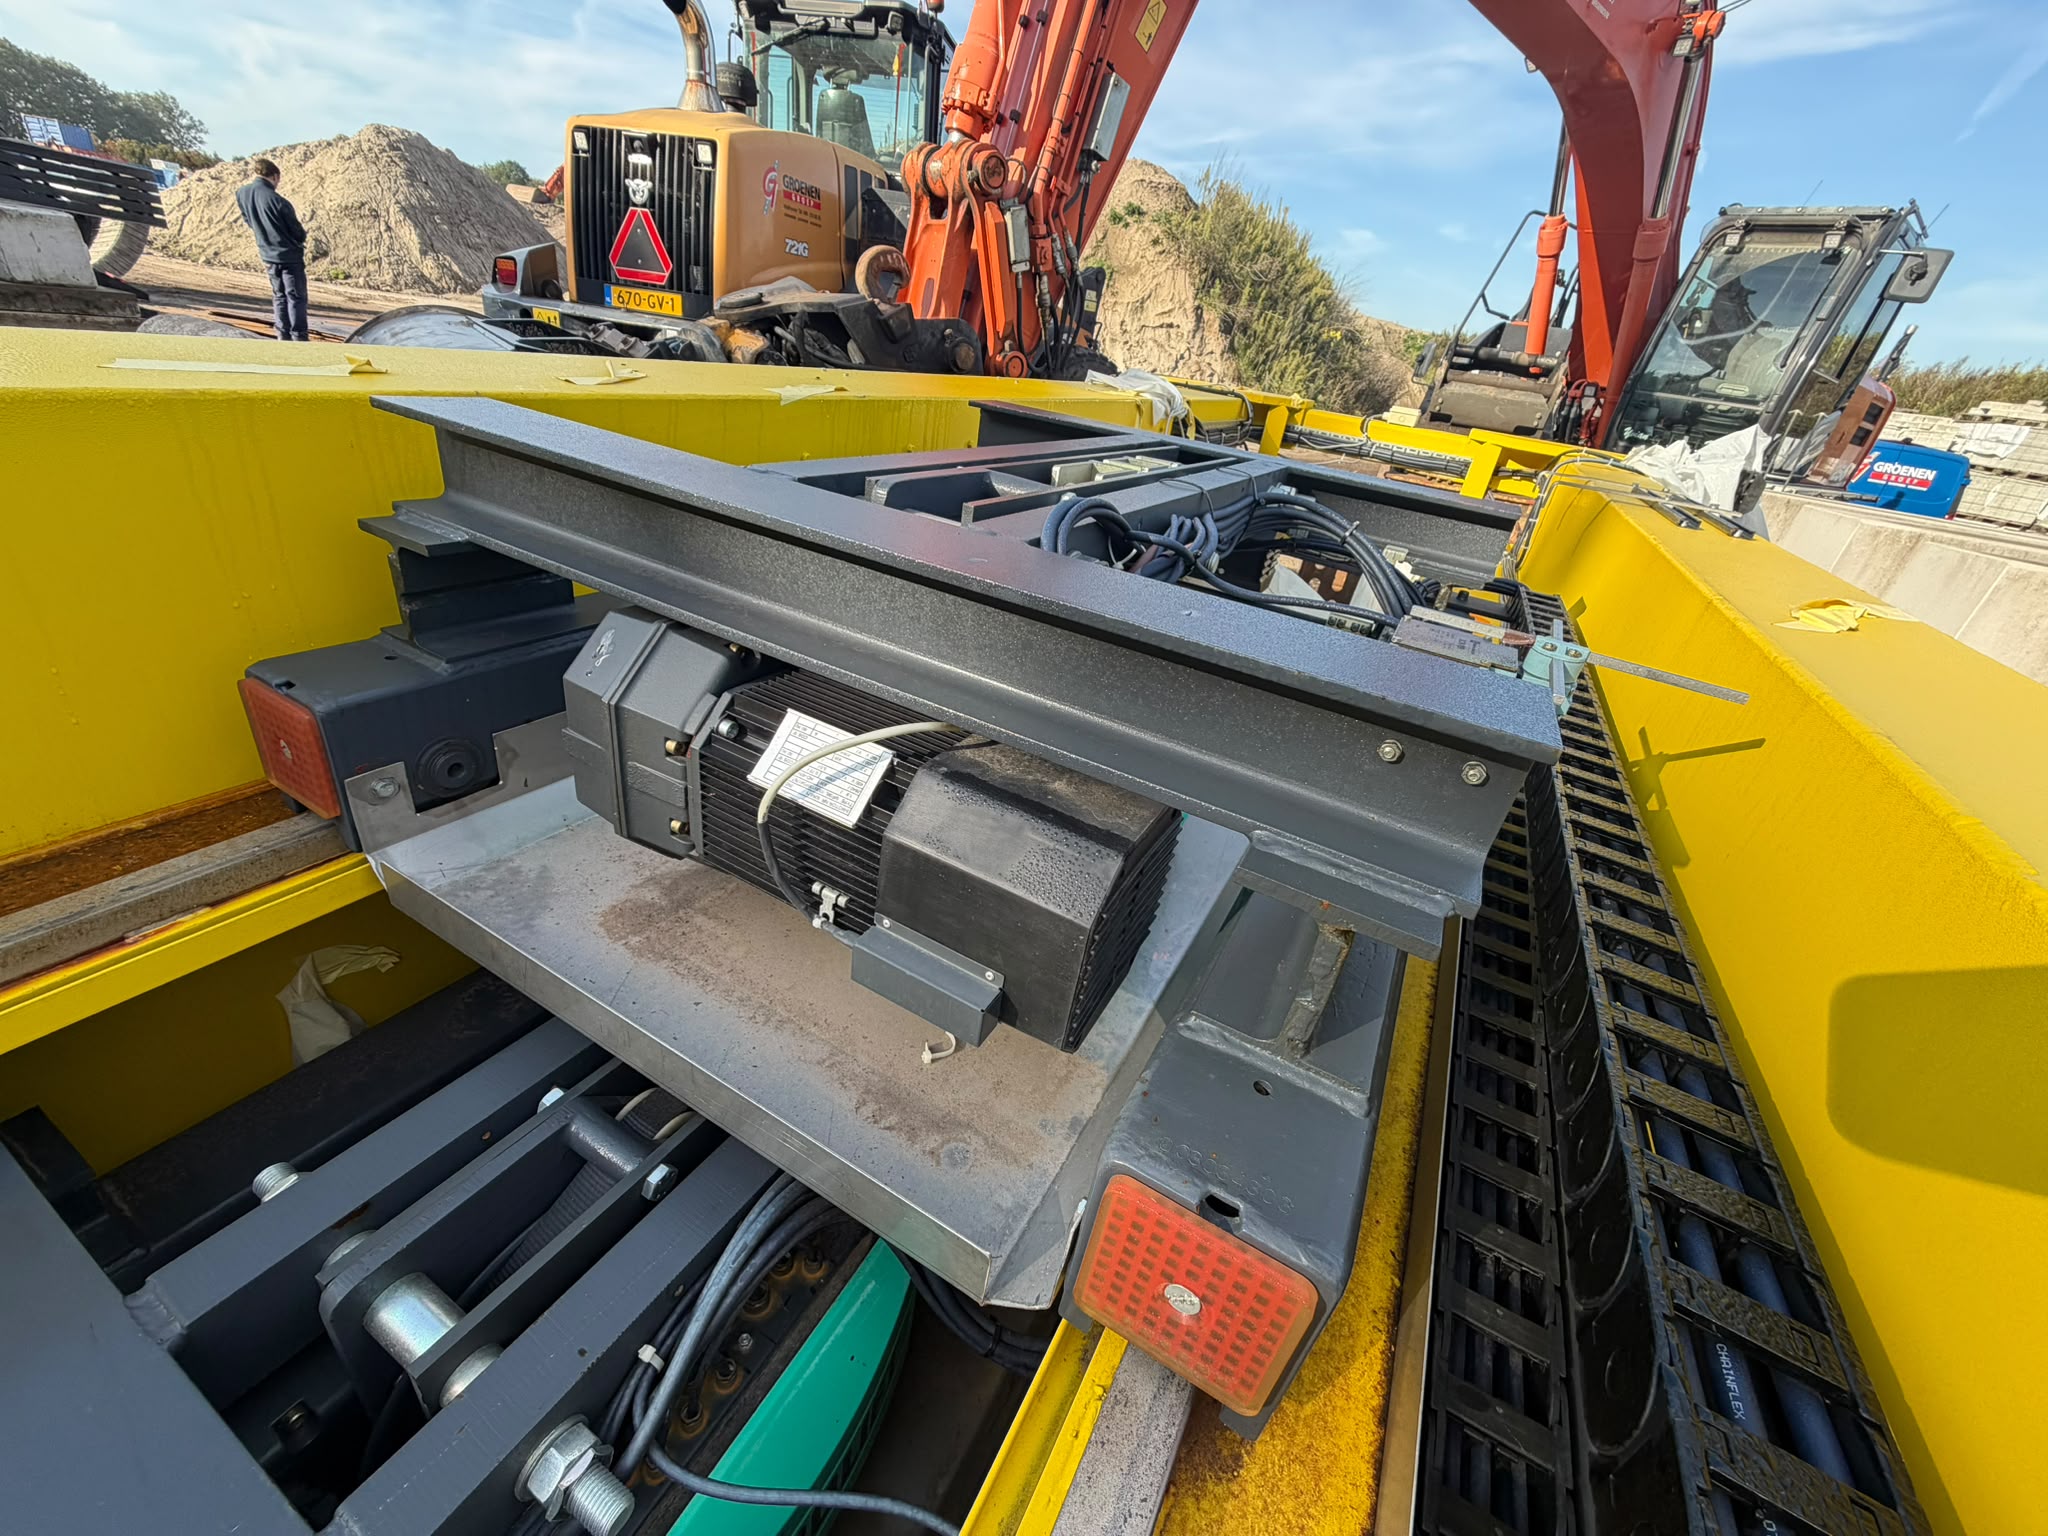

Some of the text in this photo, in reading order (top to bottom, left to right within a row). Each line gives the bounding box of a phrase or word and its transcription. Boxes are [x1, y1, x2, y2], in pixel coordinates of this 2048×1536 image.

[783, 174, 821, 201] GROENEN
[784, 237, 809, 258] 721G
[616, 289, 675, 312] 670-GV-1
[1873, 461, 1937, 481] GROENEN
[1716, 1343, 1746, 1420] CHAINFLEX
